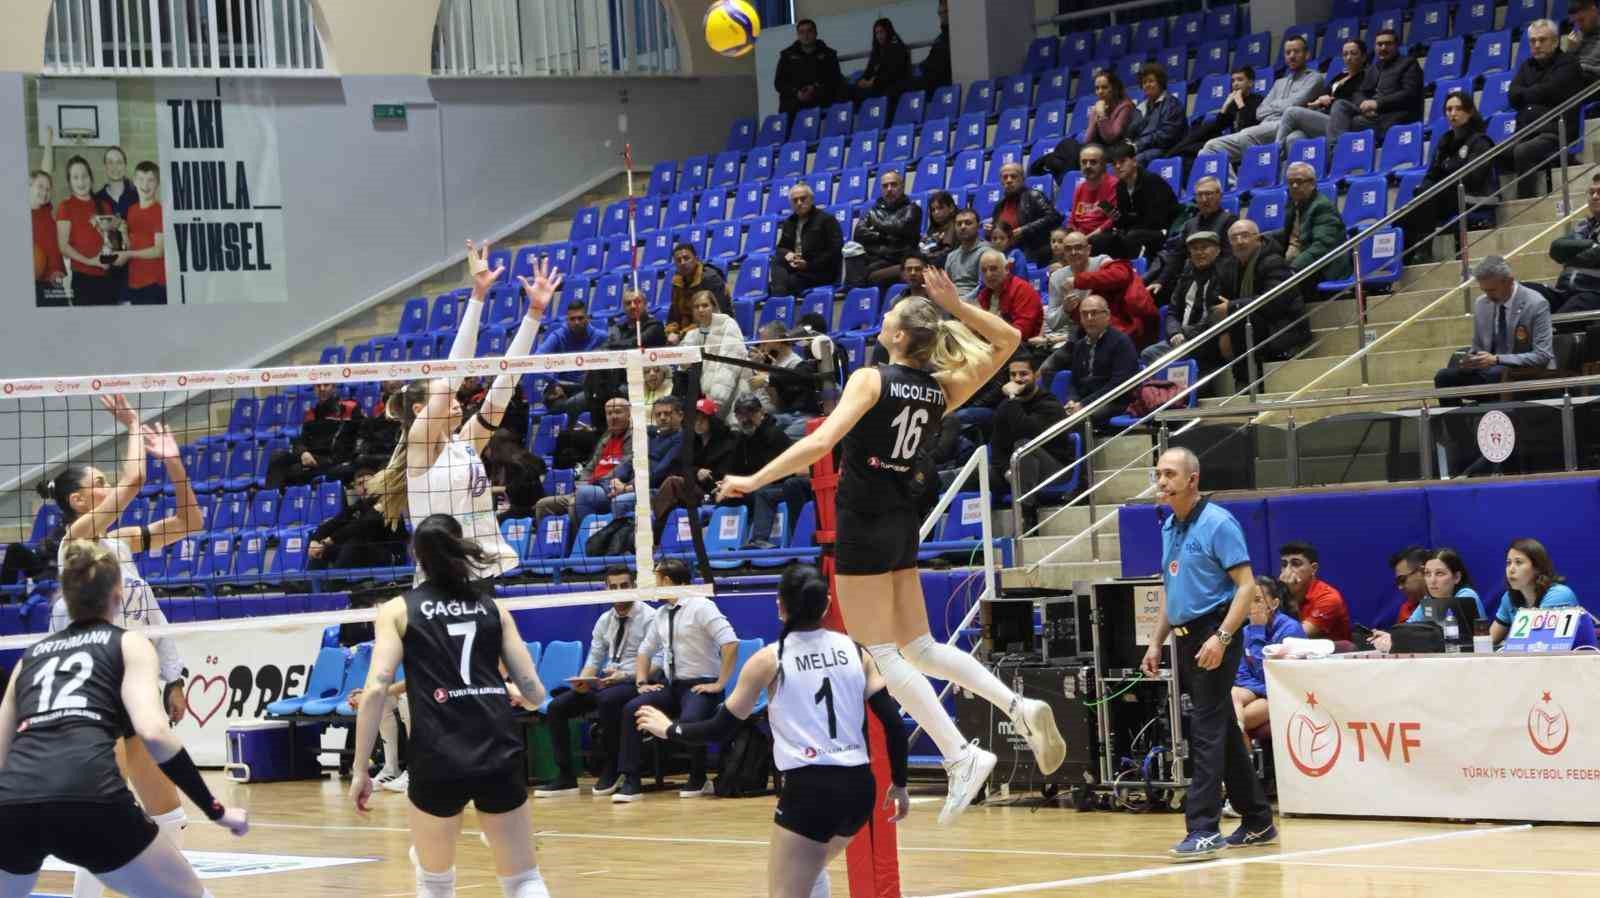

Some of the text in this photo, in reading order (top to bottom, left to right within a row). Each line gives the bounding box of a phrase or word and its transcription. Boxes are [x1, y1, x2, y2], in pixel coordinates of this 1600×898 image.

[171, 161, 250, 210] MINLA
[173, 217, 272, 272] YÜKSEL
[890, 405, 929, 460] 16
[420, 600, 488, 619] ÇAĞLA
[1513, 615, 1529, 637] 2
[1562, 614, 1573, 636] 1
[32, 630, 112, 657] ORTHMANN
[446, 621, 477, 686] 7
[32, 651, 94, 713] 12
[815, 676, 837, 739] 1
[1347, 722, 1421, 763] TVF
[1462, 765, 1507, 779] TÜRKİYE
[1510, 767, 1563, 780] VOLEYBOL
